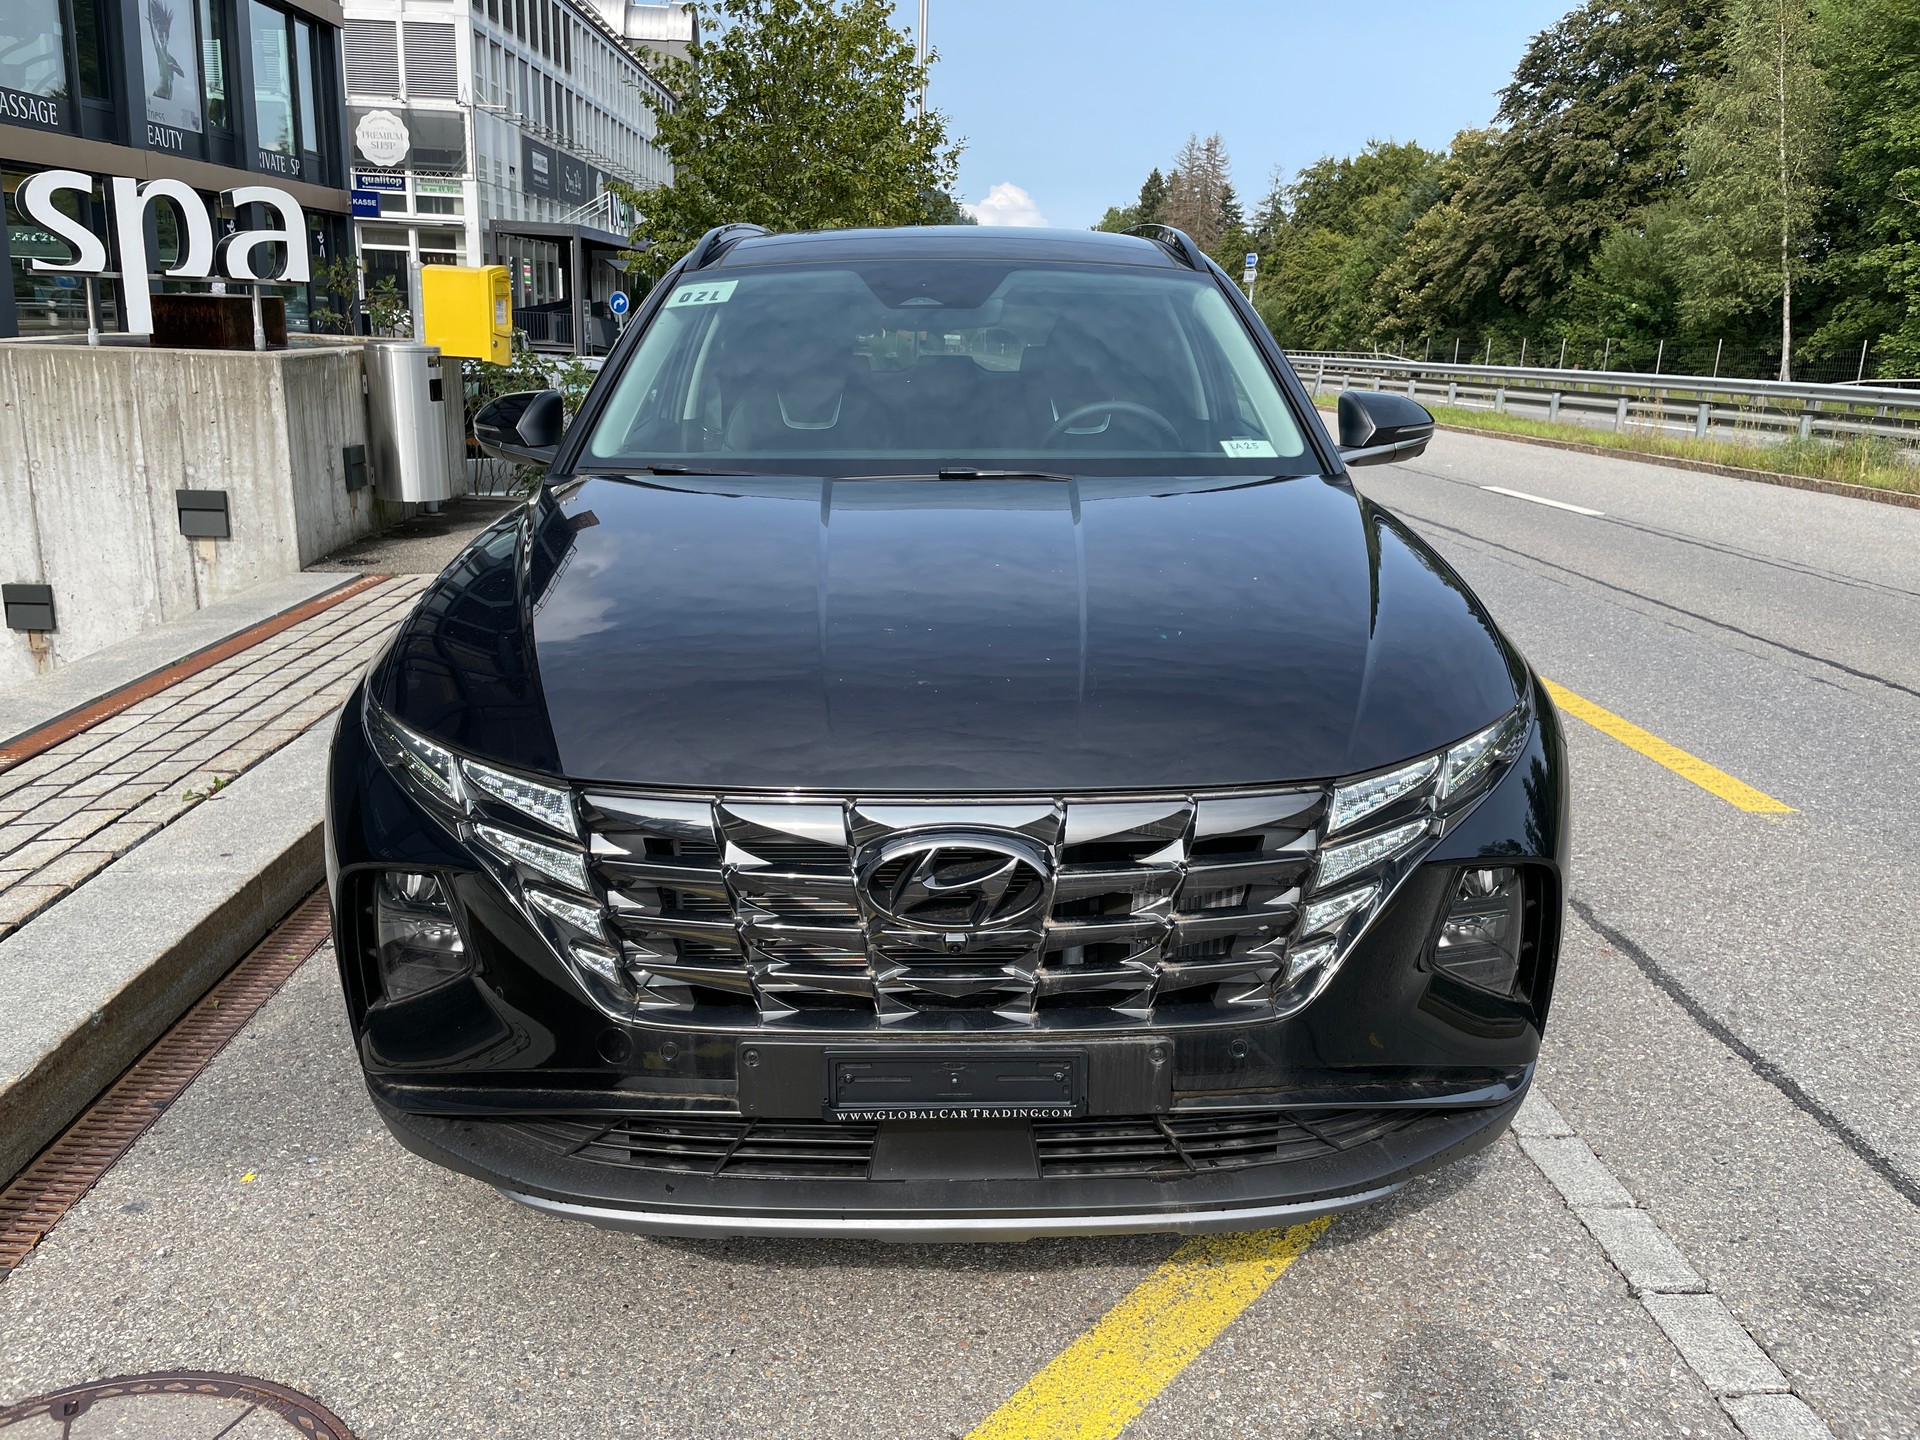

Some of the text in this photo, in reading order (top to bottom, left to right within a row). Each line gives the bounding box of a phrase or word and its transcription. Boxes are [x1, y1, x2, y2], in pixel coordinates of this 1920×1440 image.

[147, 124, 183, 151] EAUTY
[362, 131, 404, 141] PREMIUM
[361, 176, 403, 187] qualitop
[352, 198, 377, 207] KASSE
[16, 170, 310, 334] spa
